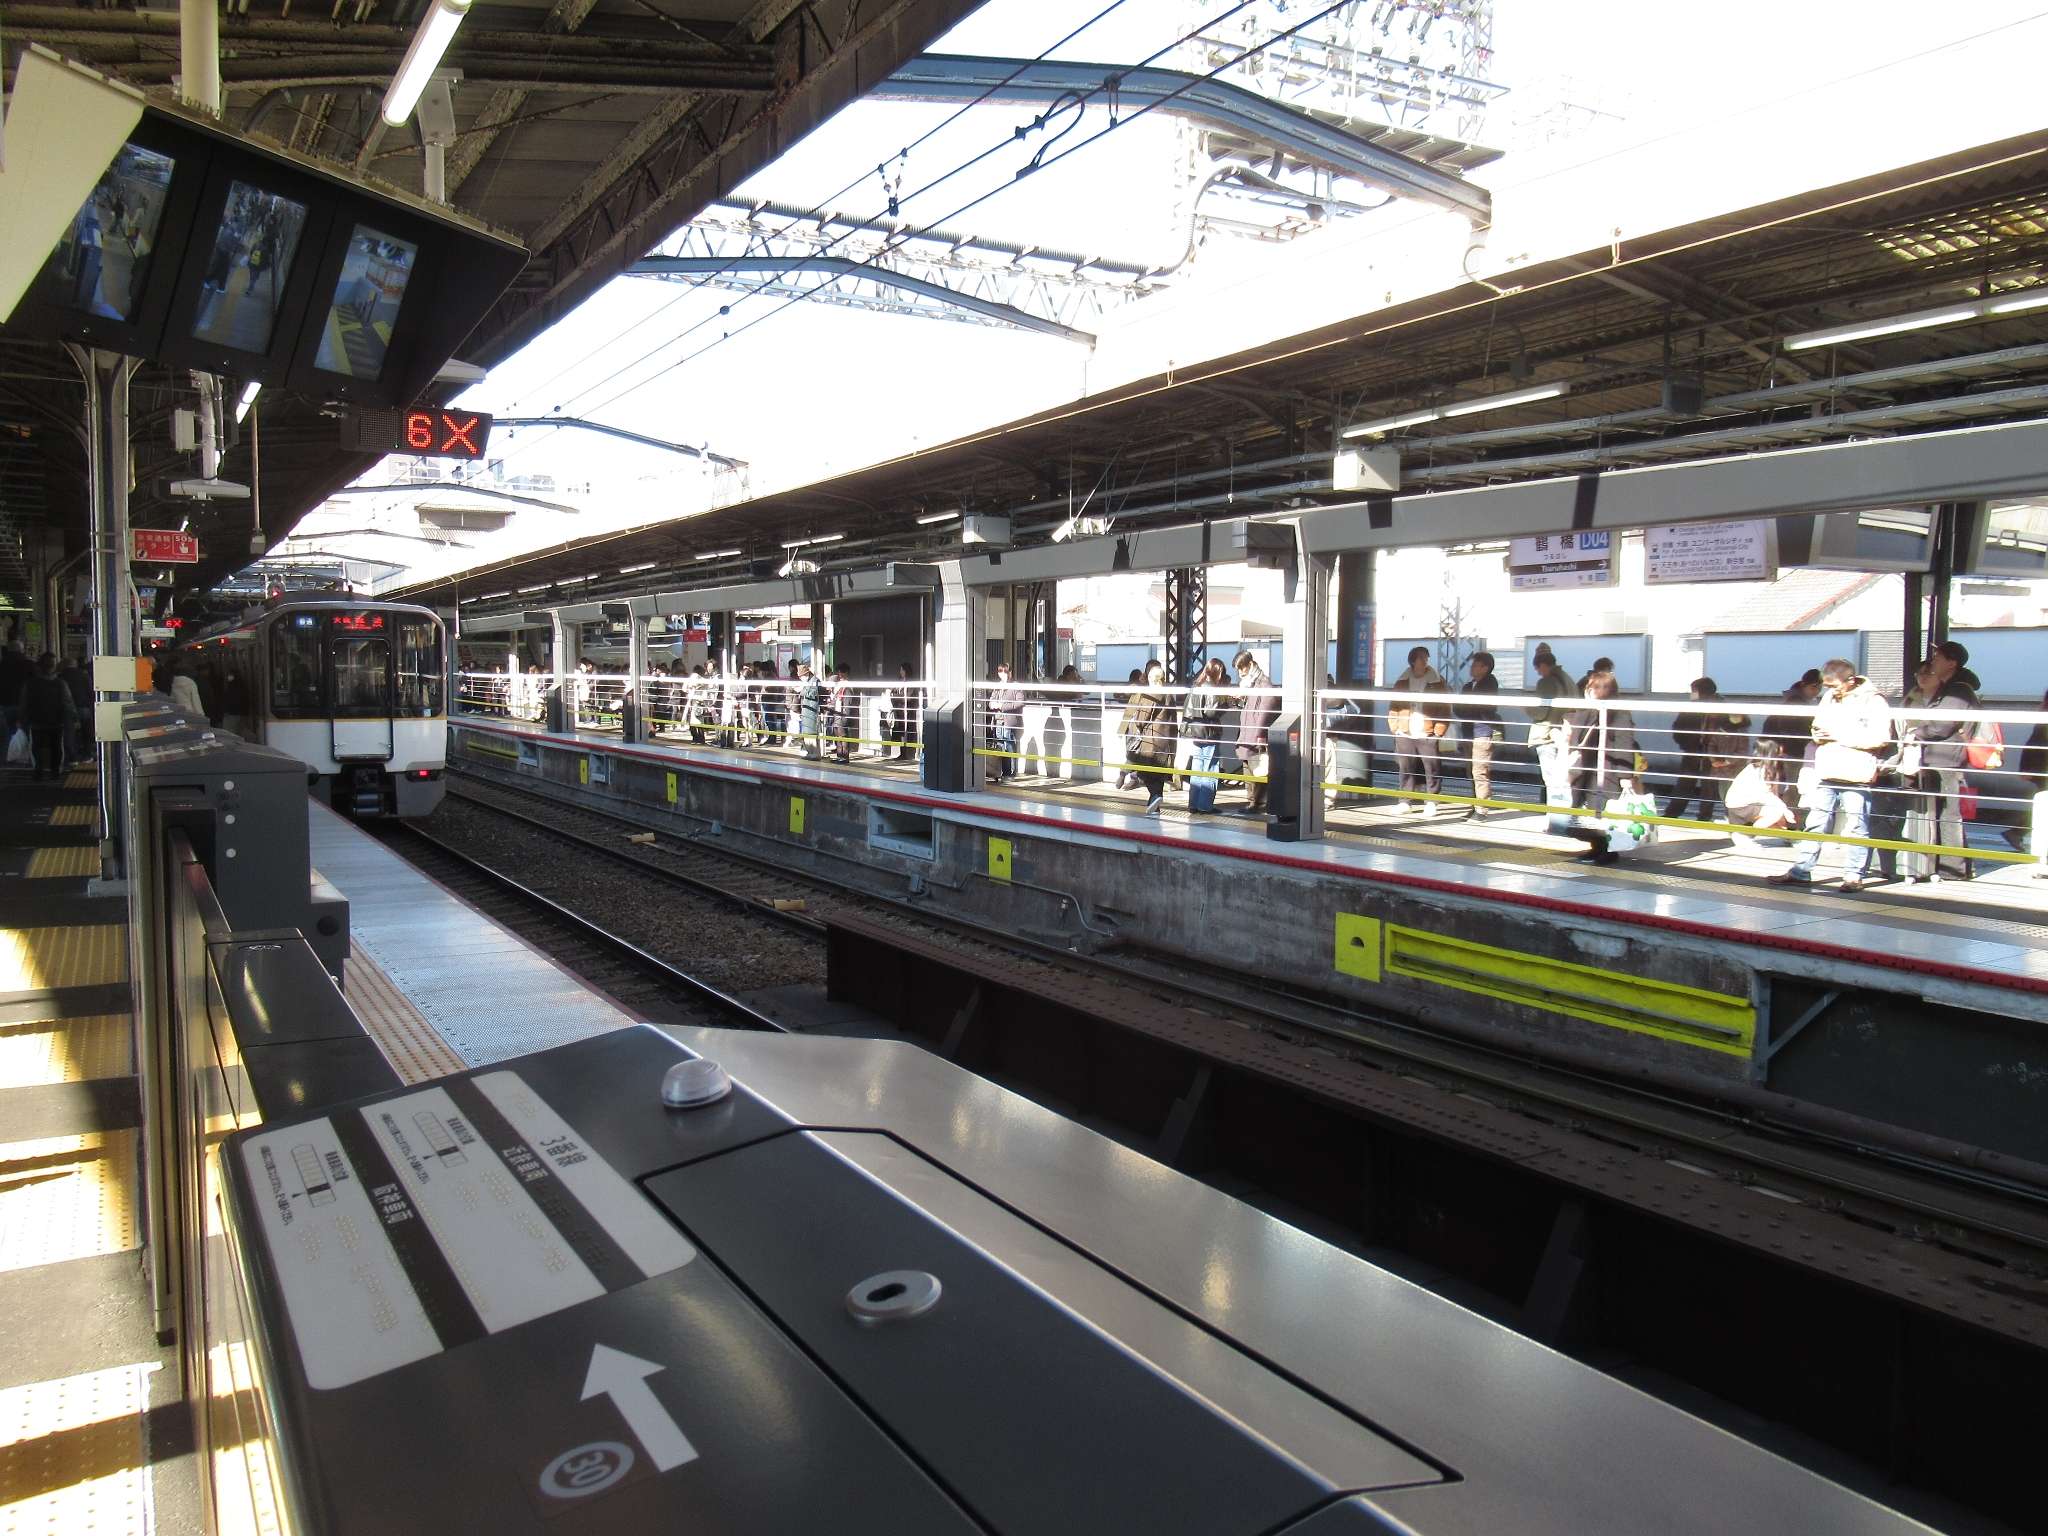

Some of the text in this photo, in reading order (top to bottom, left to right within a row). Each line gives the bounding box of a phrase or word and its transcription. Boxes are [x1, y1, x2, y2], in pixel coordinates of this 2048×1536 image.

[175, 535, 193, 543] SOS
[1582, 532, 1608, 549] D04
[1541, 562, 1577, 574] Tsuruhashi
[503, 1144, 549, 1183] 近鉄車両
[540, 1135, 588, 1168] 3番線
[371, 1182, 414, 1225] 阪神車両
